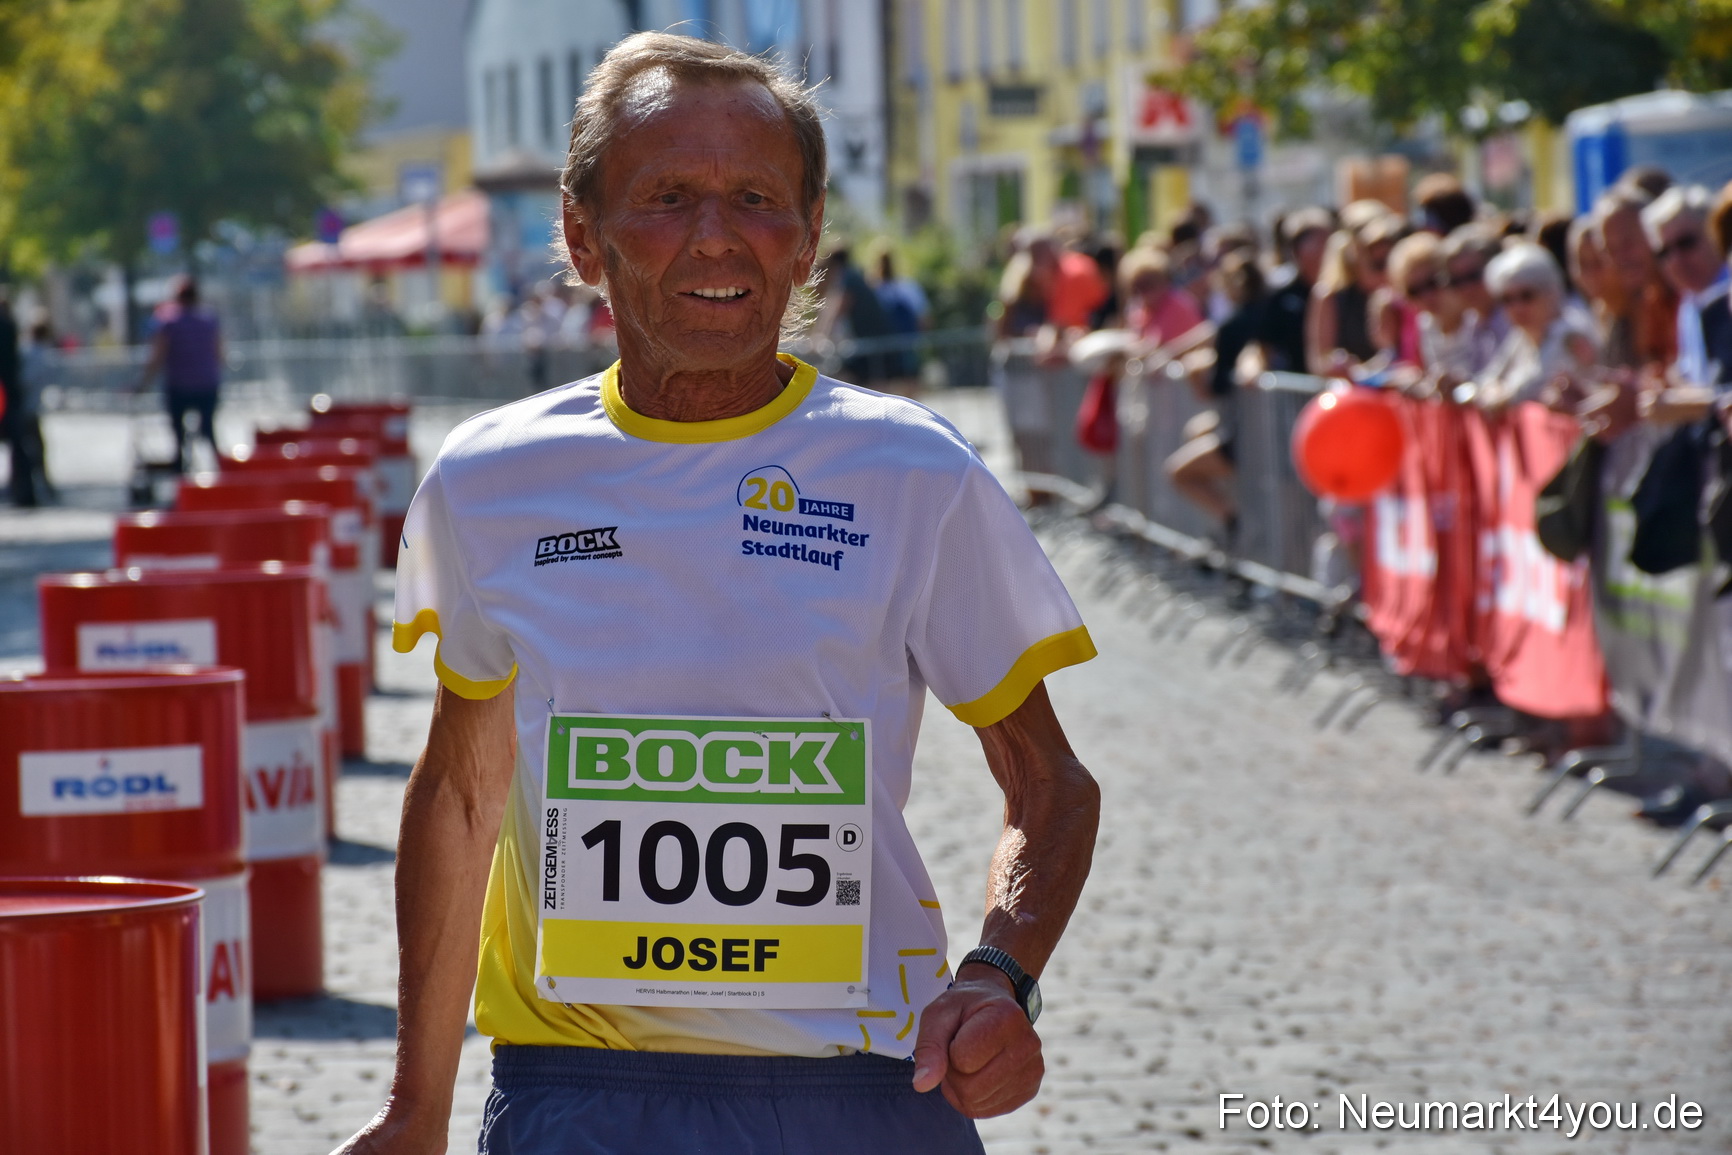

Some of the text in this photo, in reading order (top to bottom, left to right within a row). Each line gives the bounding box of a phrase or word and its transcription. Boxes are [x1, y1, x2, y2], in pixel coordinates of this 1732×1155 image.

[744, 477, 849, 517] 20 JAHRE
[535, 526, 621, 559] BOCK
[743, 514, 870, 547] Neumarkter
[560, 555, 569, 563] by
[592, 551, 623, 559] concepts
[742, 540, 844, 571] Stadtlauf
[568, 728, 845, 794] BOCK
[843, 829, 857, 845] D
[581, 820, 831, 907] 1005
[622, 936, 780, 972] JOSEF
